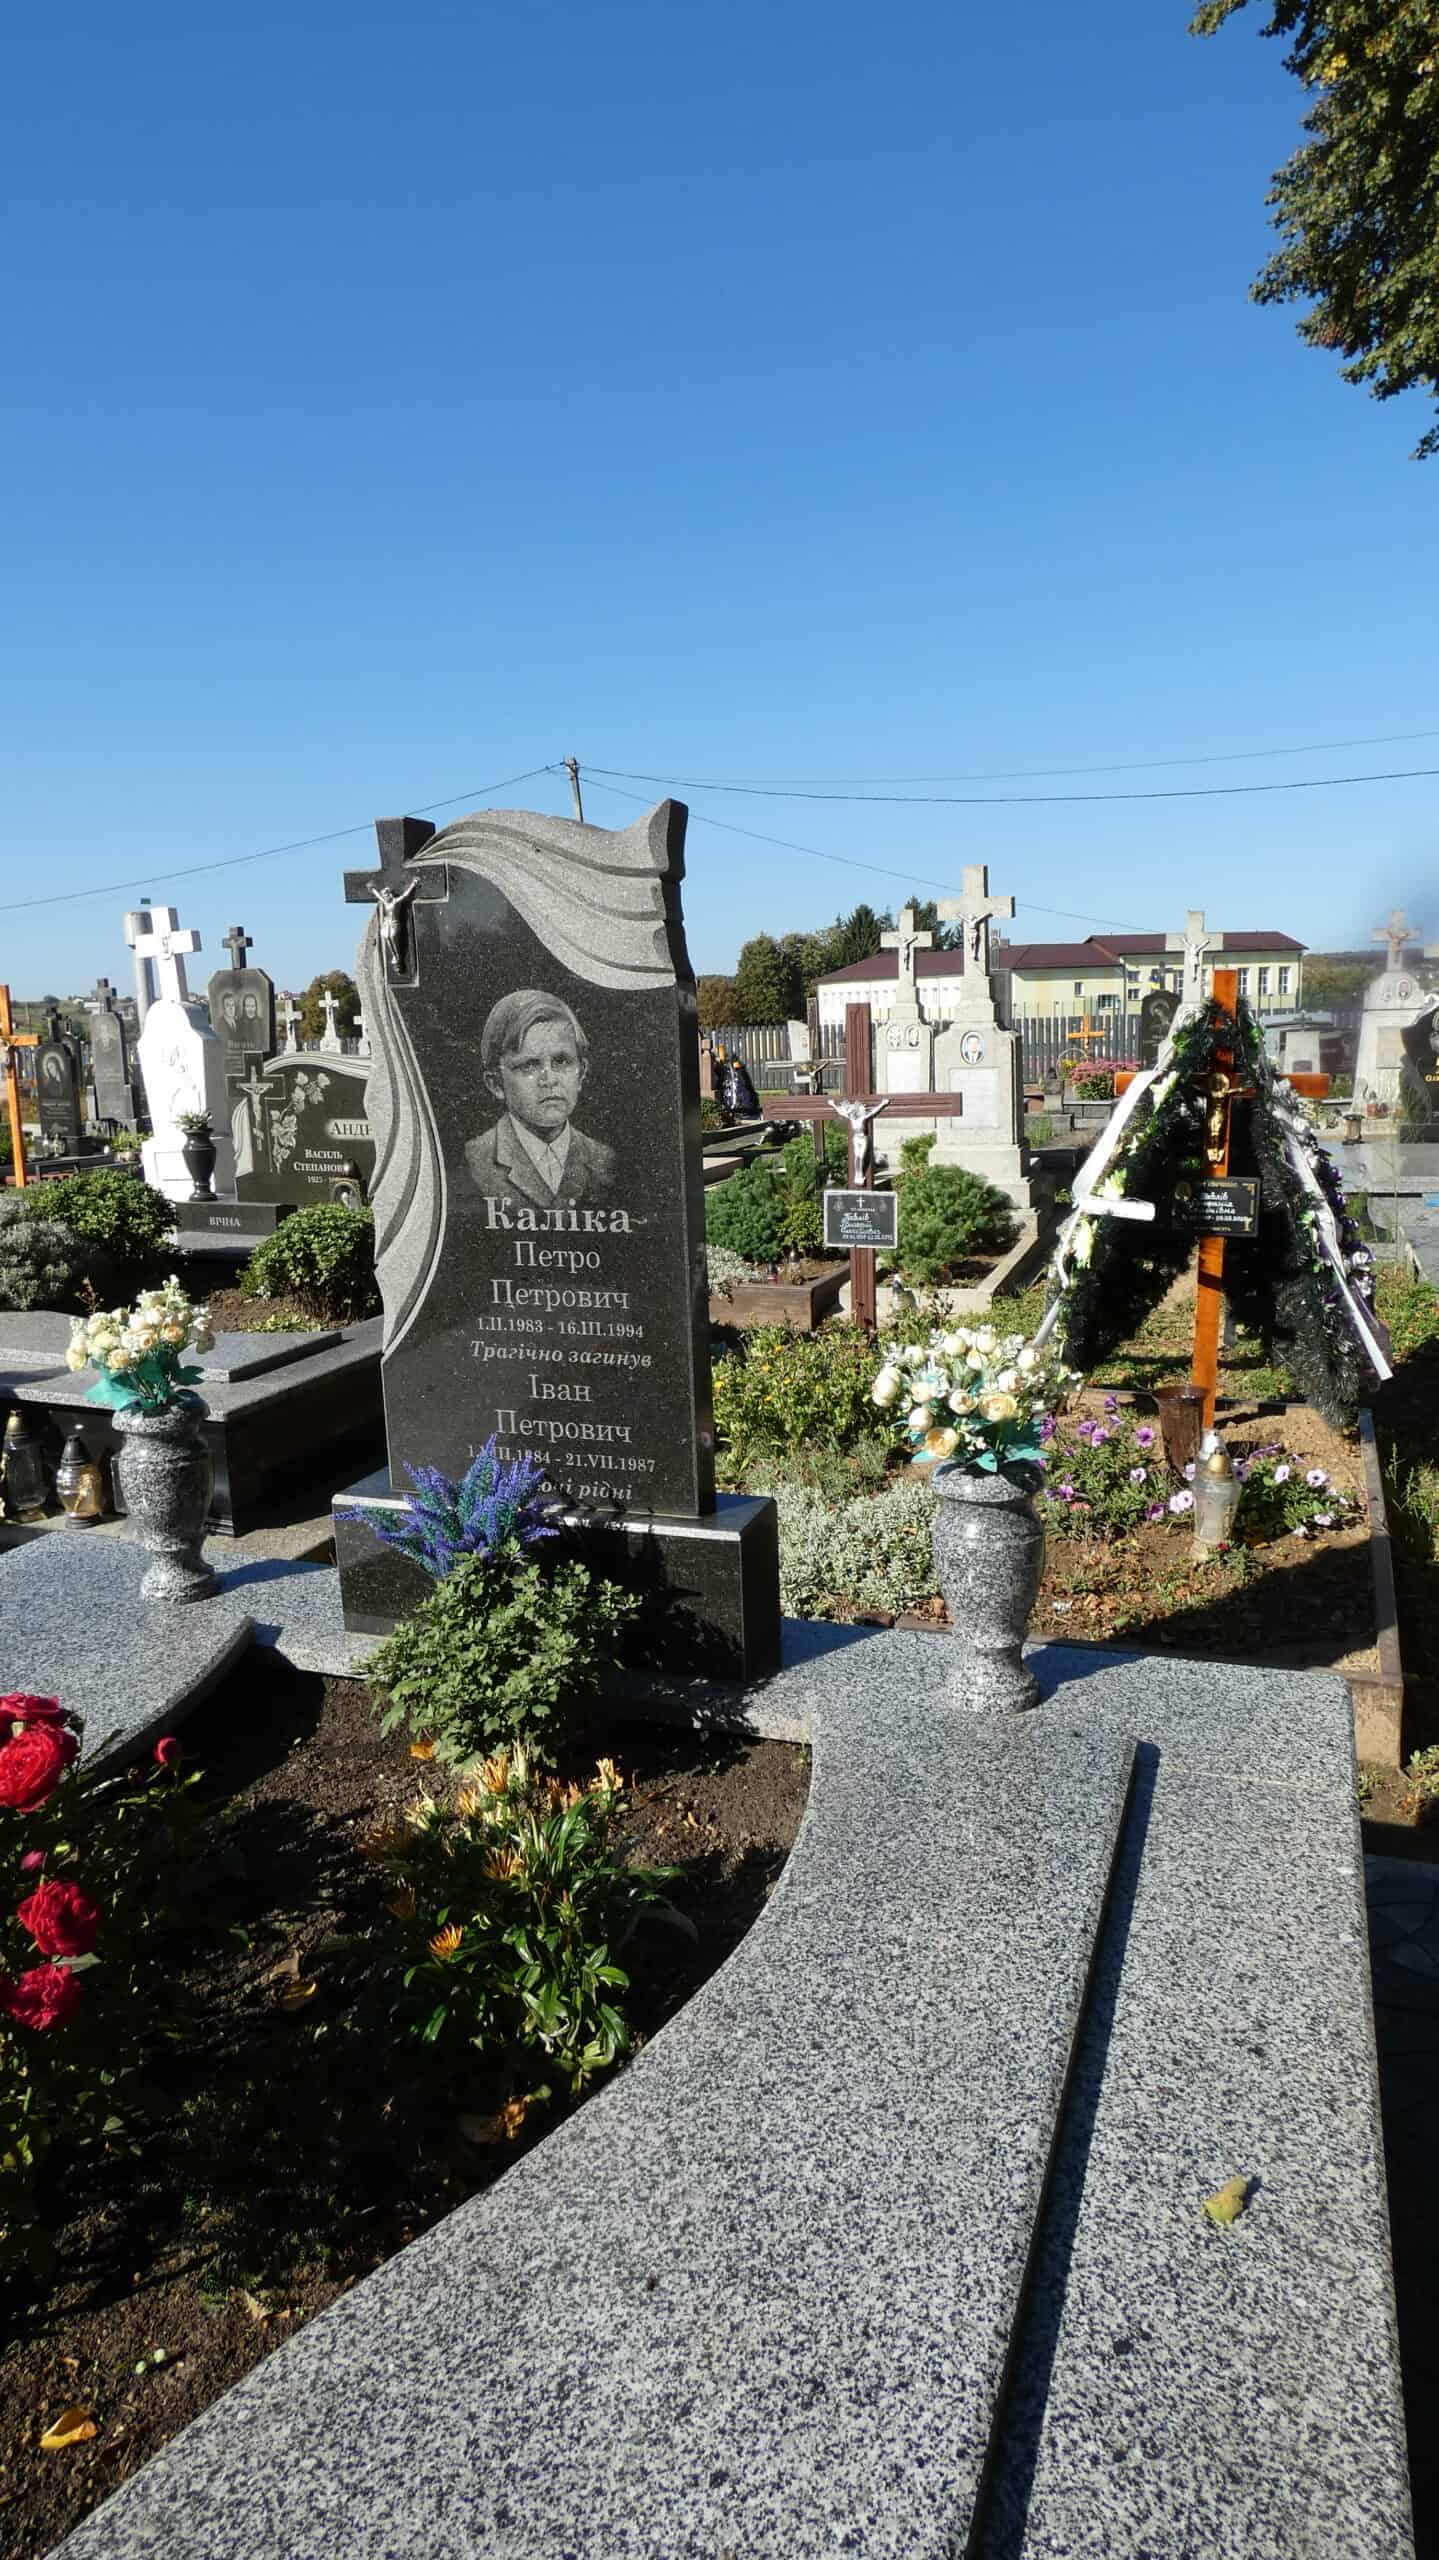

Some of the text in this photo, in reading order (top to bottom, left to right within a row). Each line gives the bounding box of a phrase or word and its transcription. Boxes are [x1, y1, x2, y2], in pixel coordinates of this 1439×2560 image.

[483, 1196, 633, 1233] Каліка
[513, 1240, 600, 1274] Петро
[490, 1279, 630, 1312] Петрович
[471, 1341, 652, 1370] Трагічно загинув
[528, 1374, 593, 1402] Іван
[495, 1409, 633, 1443] Петрович
